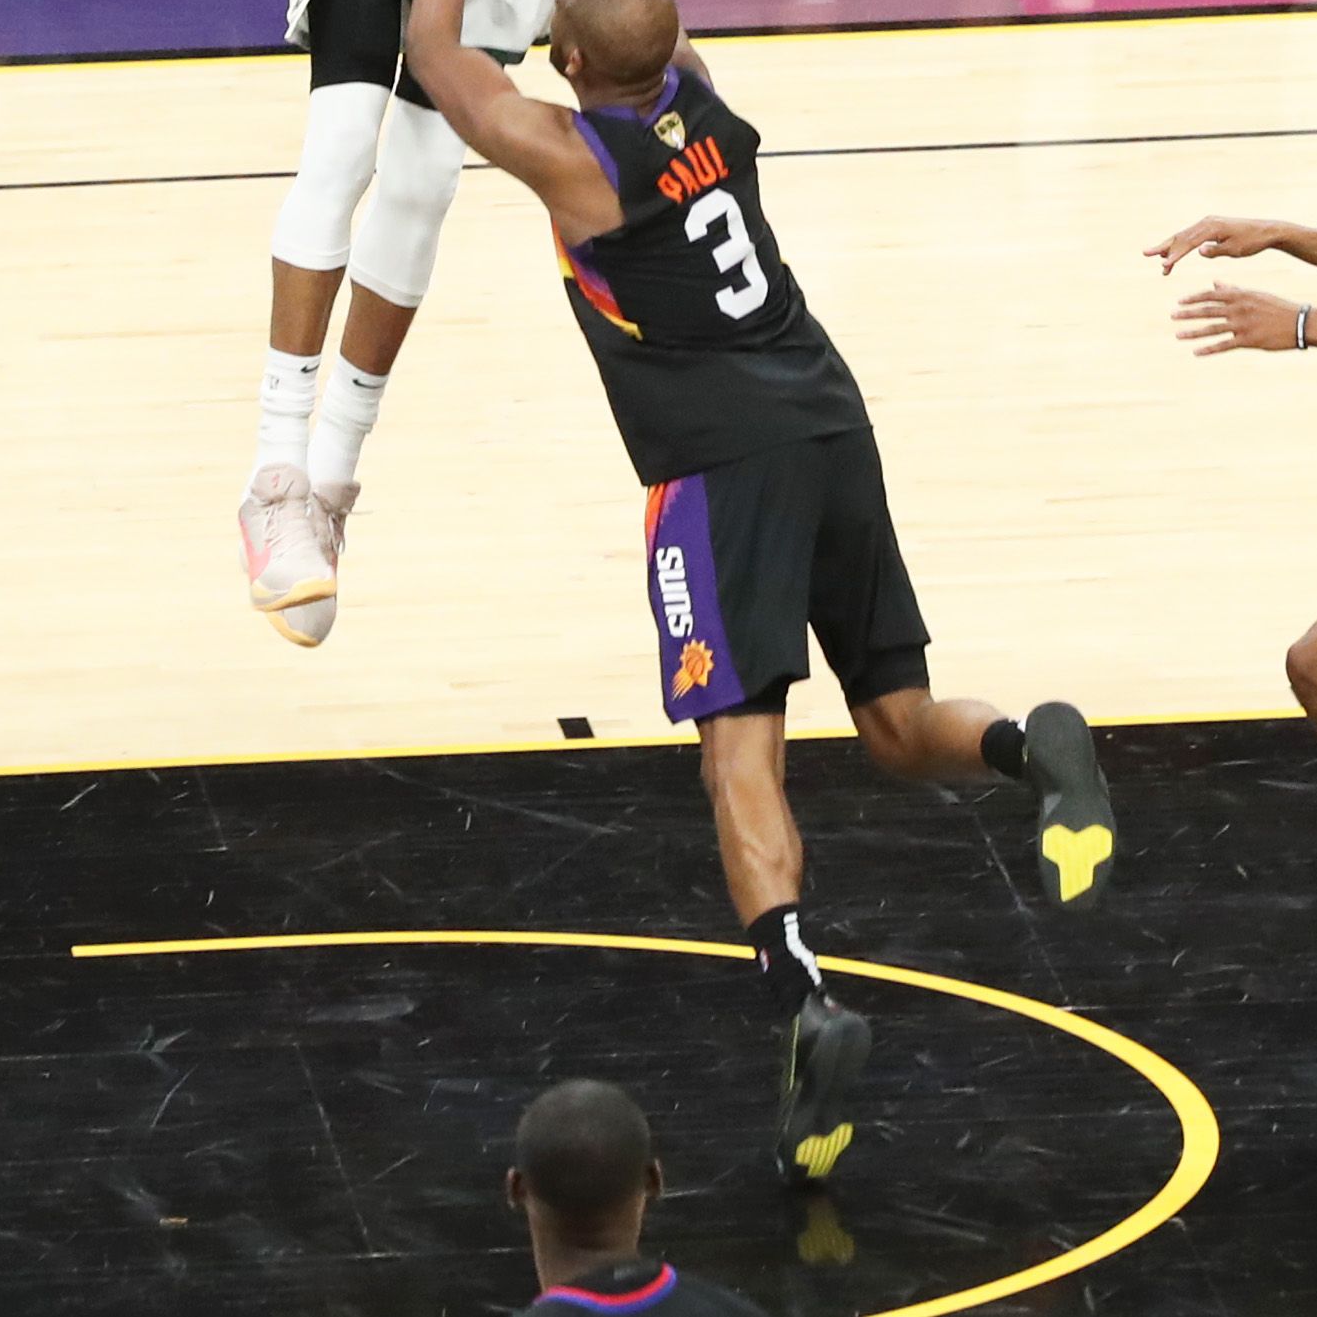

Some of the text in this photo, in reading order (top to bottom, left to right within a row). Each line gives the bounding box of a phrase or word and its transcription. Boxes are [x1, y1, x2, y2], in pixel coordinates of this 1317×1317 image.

[656, 135, 730, 204] PAUL
[684, 187, 769, 320] 3
[655, 545, 694, 638] SUNS
